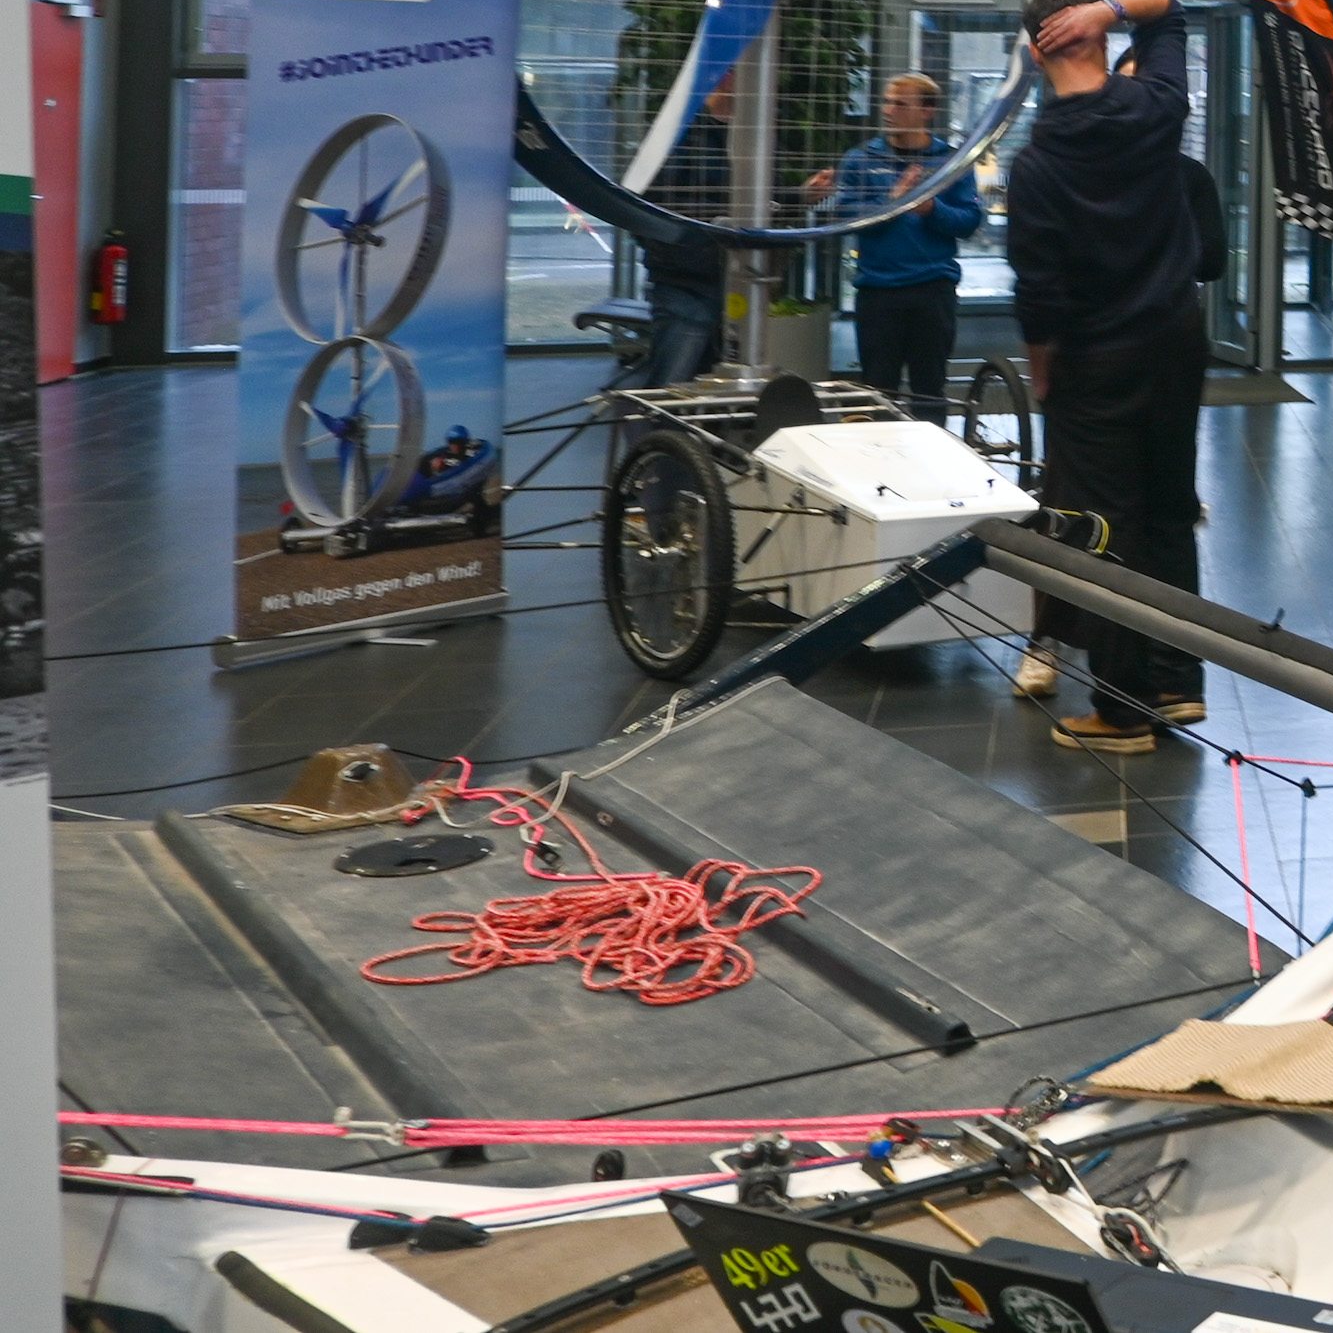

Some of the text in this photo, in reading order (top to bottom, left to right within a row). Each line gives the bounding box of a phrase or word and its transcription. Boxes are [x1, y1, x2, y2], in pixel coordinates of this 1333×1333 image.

[295, 586, 353, 606] Vollgas
[353, 577, 402, 601] gegen
[403, 571, 436, 589] den
[720, 1243, 800, 1291] 49er
